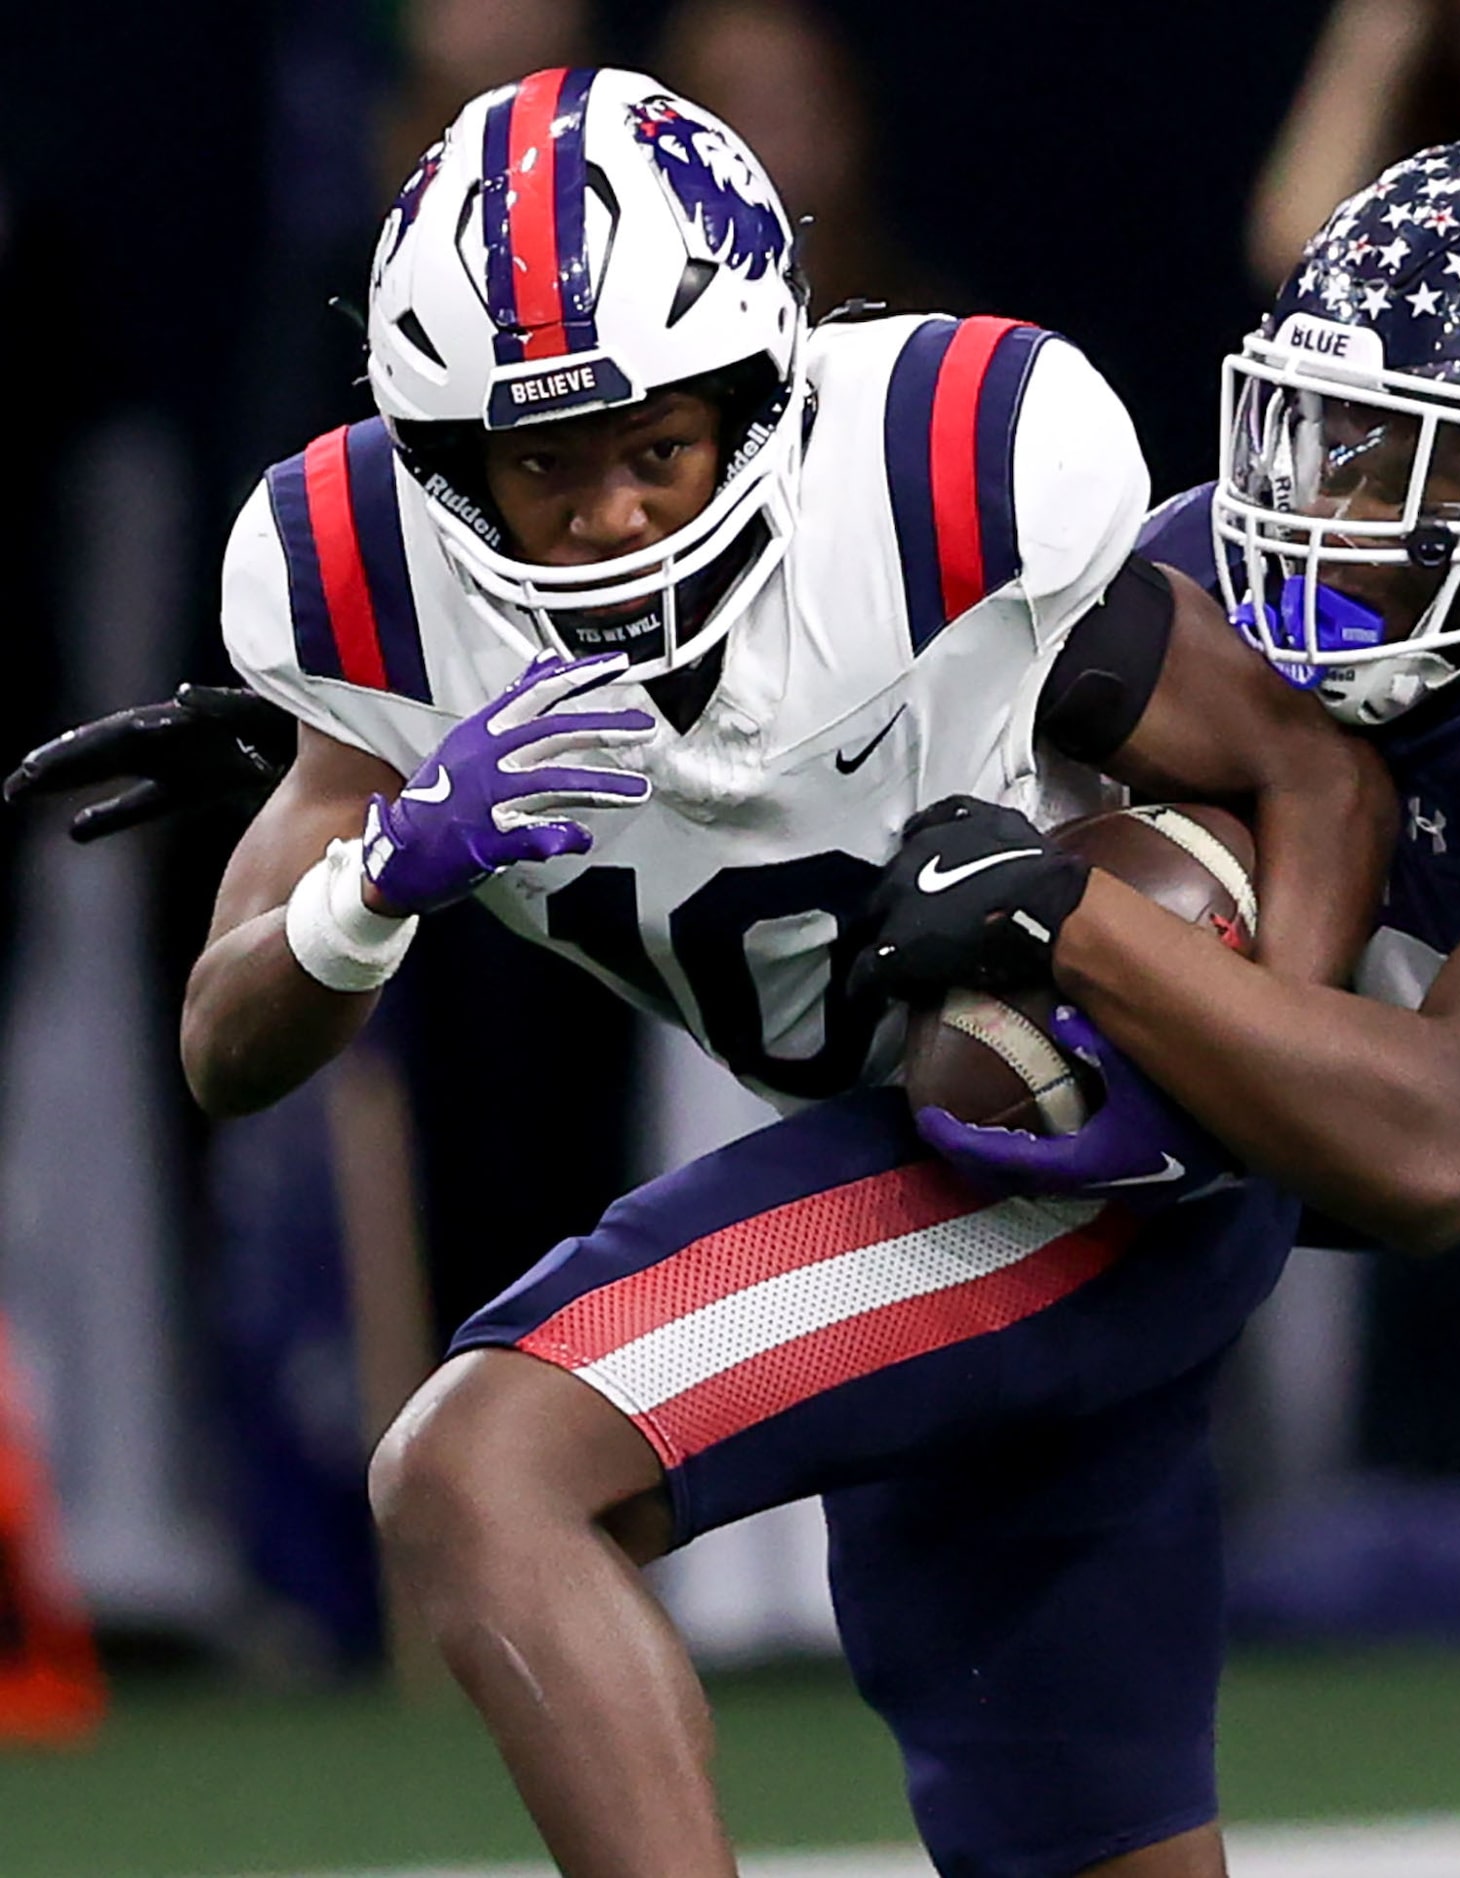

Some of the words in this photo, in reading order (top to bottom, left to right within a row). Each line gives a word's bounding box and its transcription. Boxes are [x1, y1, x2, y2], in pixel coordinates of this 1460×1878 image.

[1290, 324, 1351, 358] BLUE
[511, 367, 596, 404] BELIEVE
[715, 421, 771, 497] ddell
[424, 472, 500, 548] Riddell
[545, 848, 905, 1100] 10
